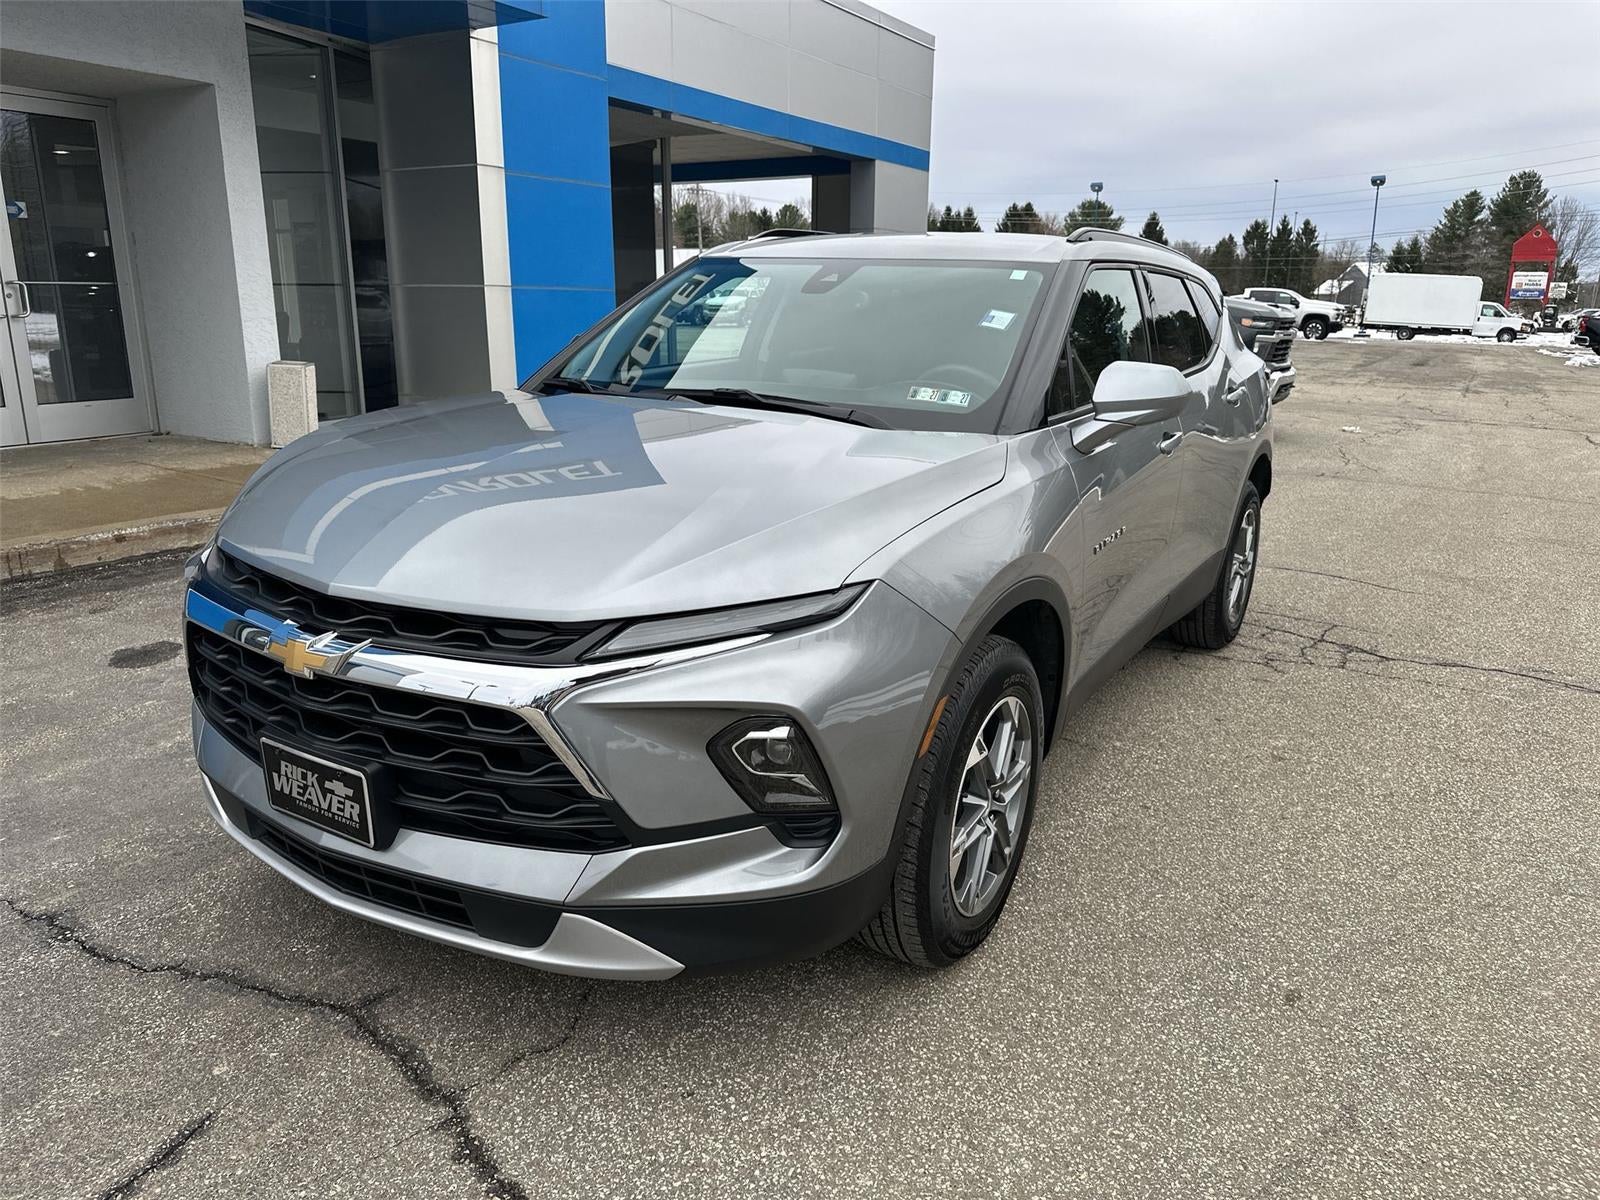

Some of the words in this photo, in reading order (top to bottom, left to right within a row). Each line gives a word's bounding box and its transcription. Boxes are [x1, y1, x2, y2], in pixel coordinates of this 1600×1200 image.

[281, 760, 319, 788] RICK
[272, 771, 360, 822] WEAVER
[296, 799, 319, 813] FAMOUS
[321, 810, 333, 818] FOR
[334, 815, 360, 830] SERVICE
